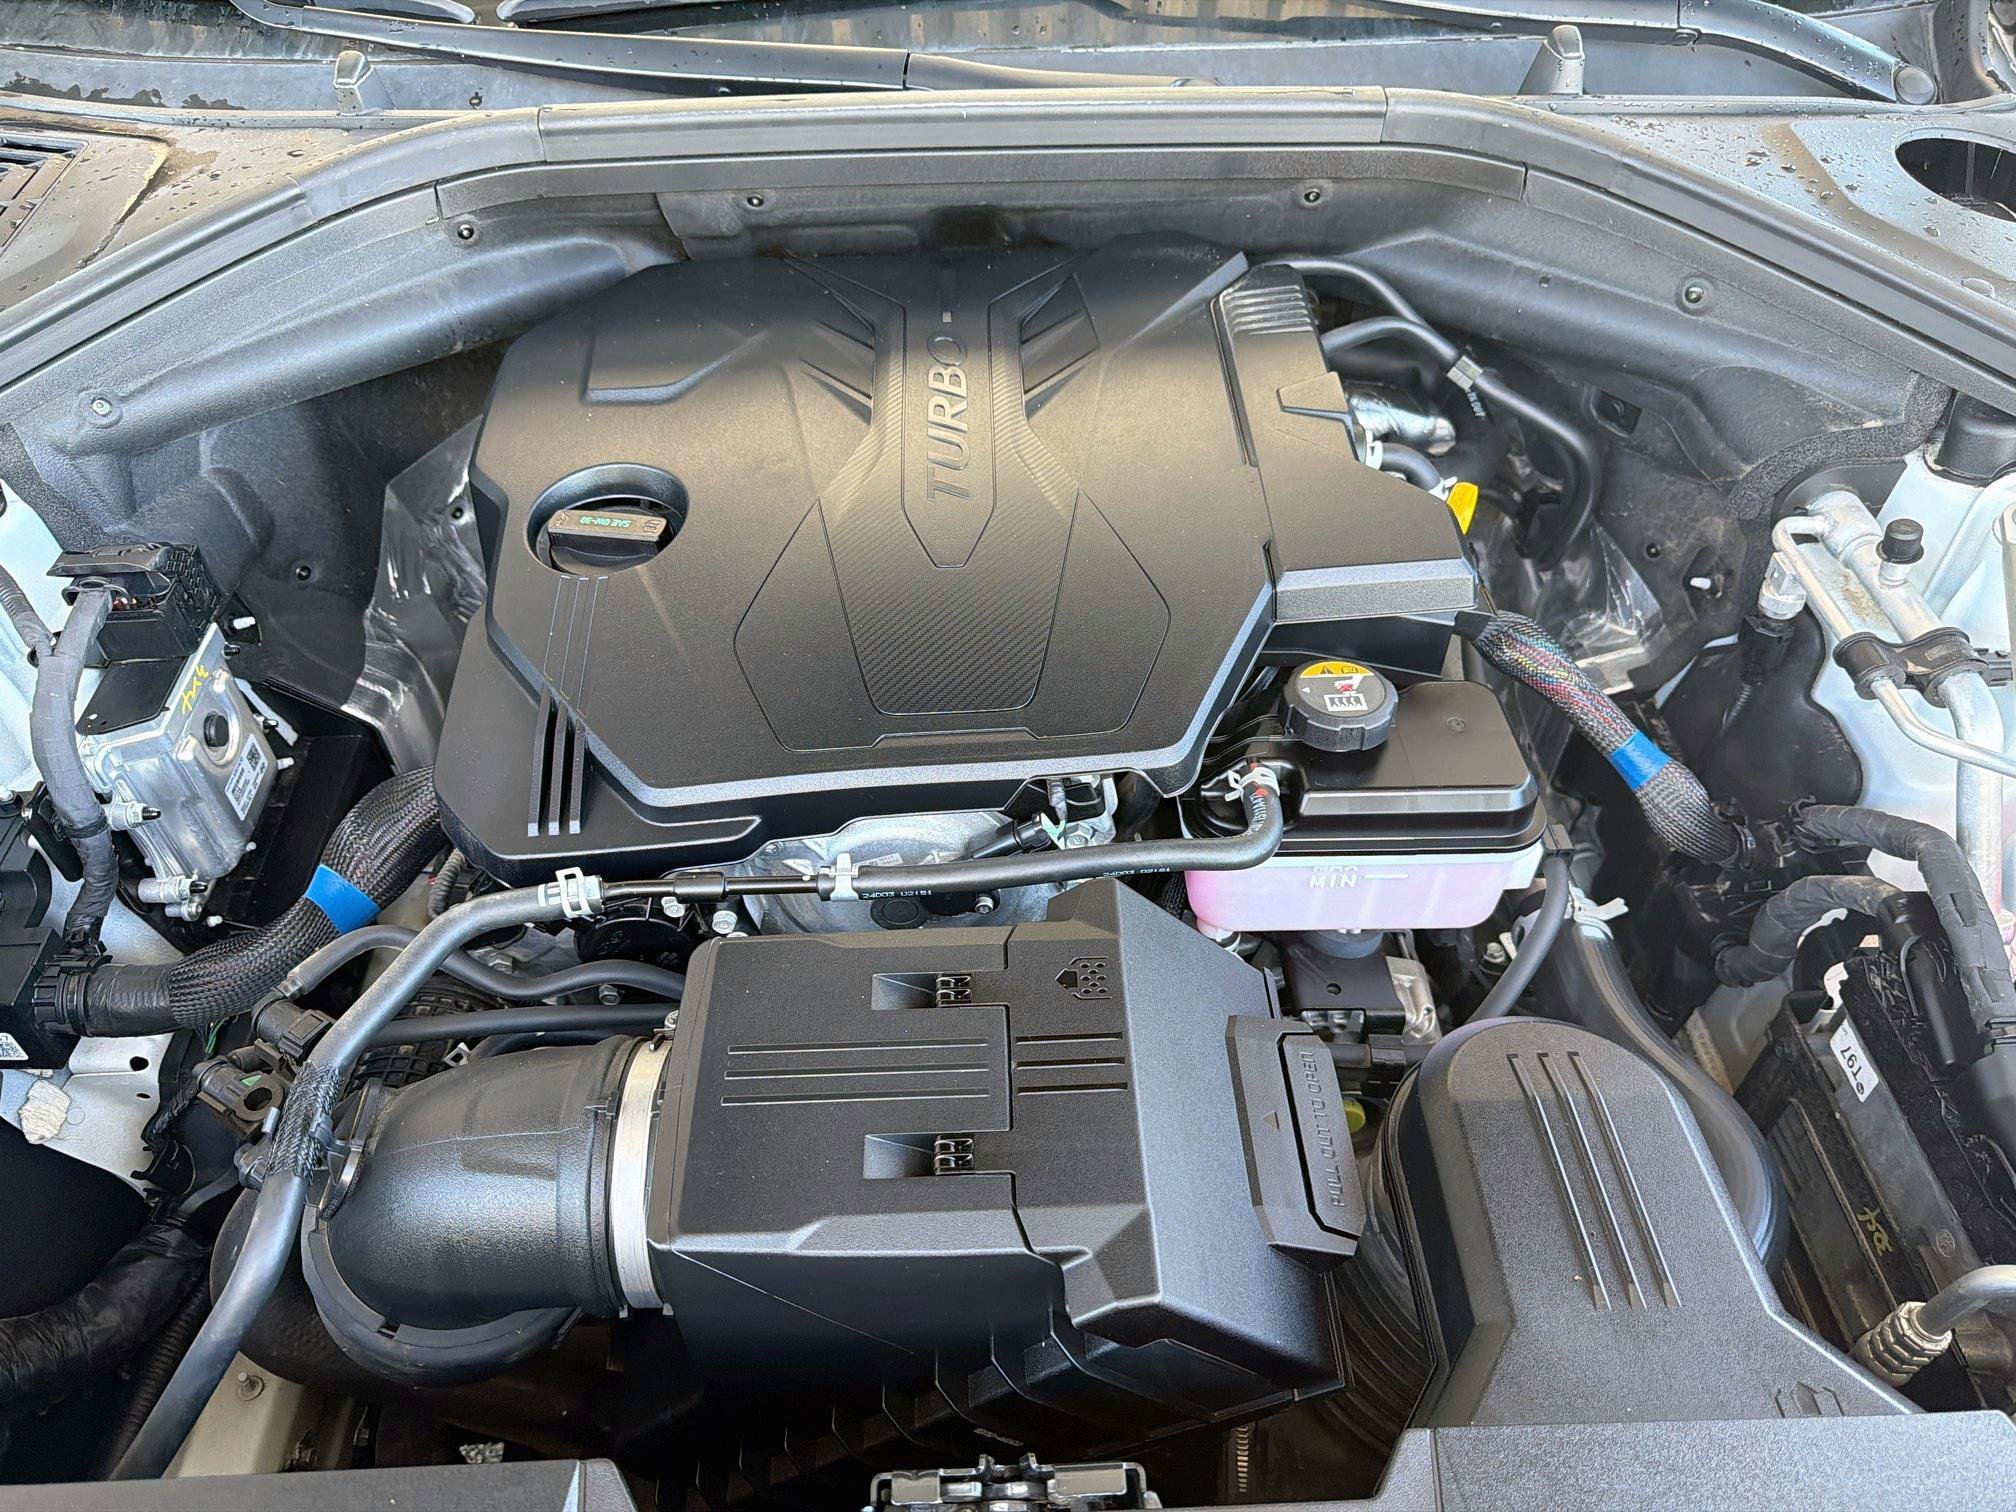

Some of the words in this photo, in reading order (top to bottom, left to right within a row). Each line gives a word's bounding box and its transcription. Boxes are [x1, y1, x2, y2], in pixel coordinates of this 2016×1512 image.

[927, 330, 970, 501] TURBO
[611, 518, 632, 528] SAE
[1309, 873, 1358, 888] MIN
[1300, 1051, 1322, 1093] OPEN
[1840, 1046, 1862, 1081] T97
[1311, 1099, 1328, 1121] TO
[1316, 1124, 1336, 1158] OUT
[1326, 1165, 1346, 1207] PULL
